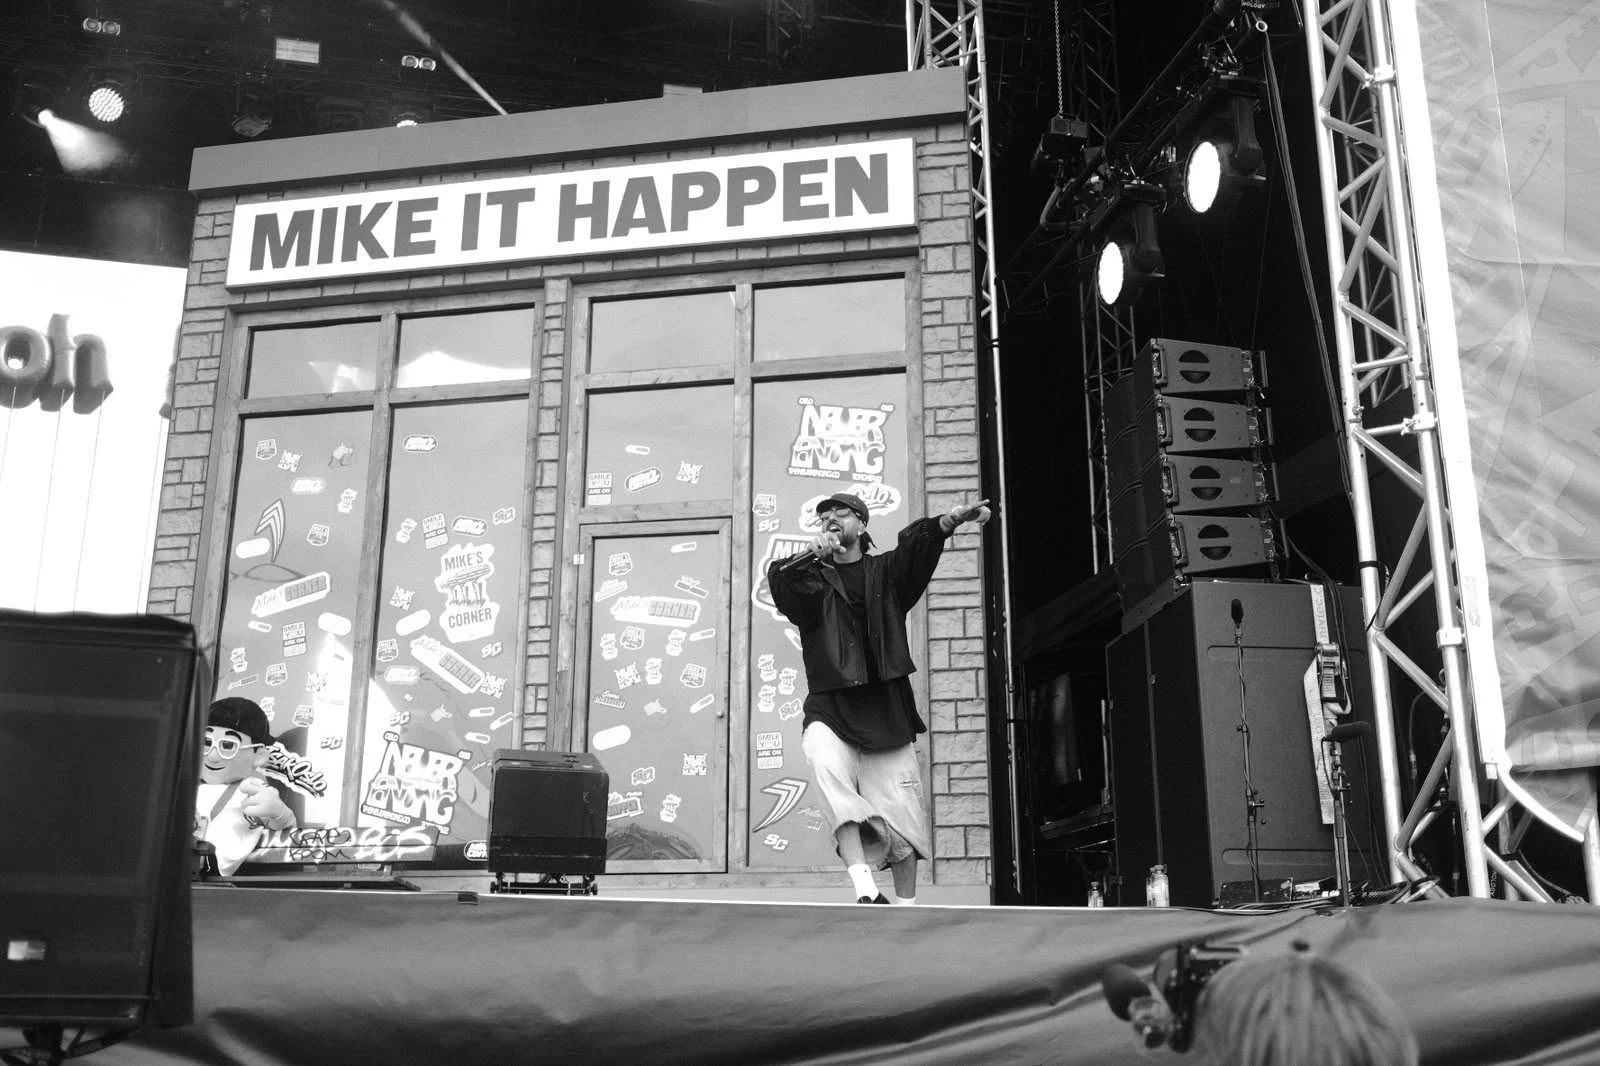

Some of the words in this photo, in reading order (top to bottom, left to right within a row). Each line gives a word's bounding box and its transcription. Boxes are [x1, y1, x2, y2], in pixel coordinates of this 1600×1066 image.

[249, 197, 438, 271] MIKE
[461, 188, 535, 251] IT
[557, 153, 890, 243] HAPPEN
[423, 514, 445, 524] SMILE
[444, 551, 484, 571] MIKE'S
[448, 607, 492, 628] CORNER
[763, 834, 789, 851] SC
